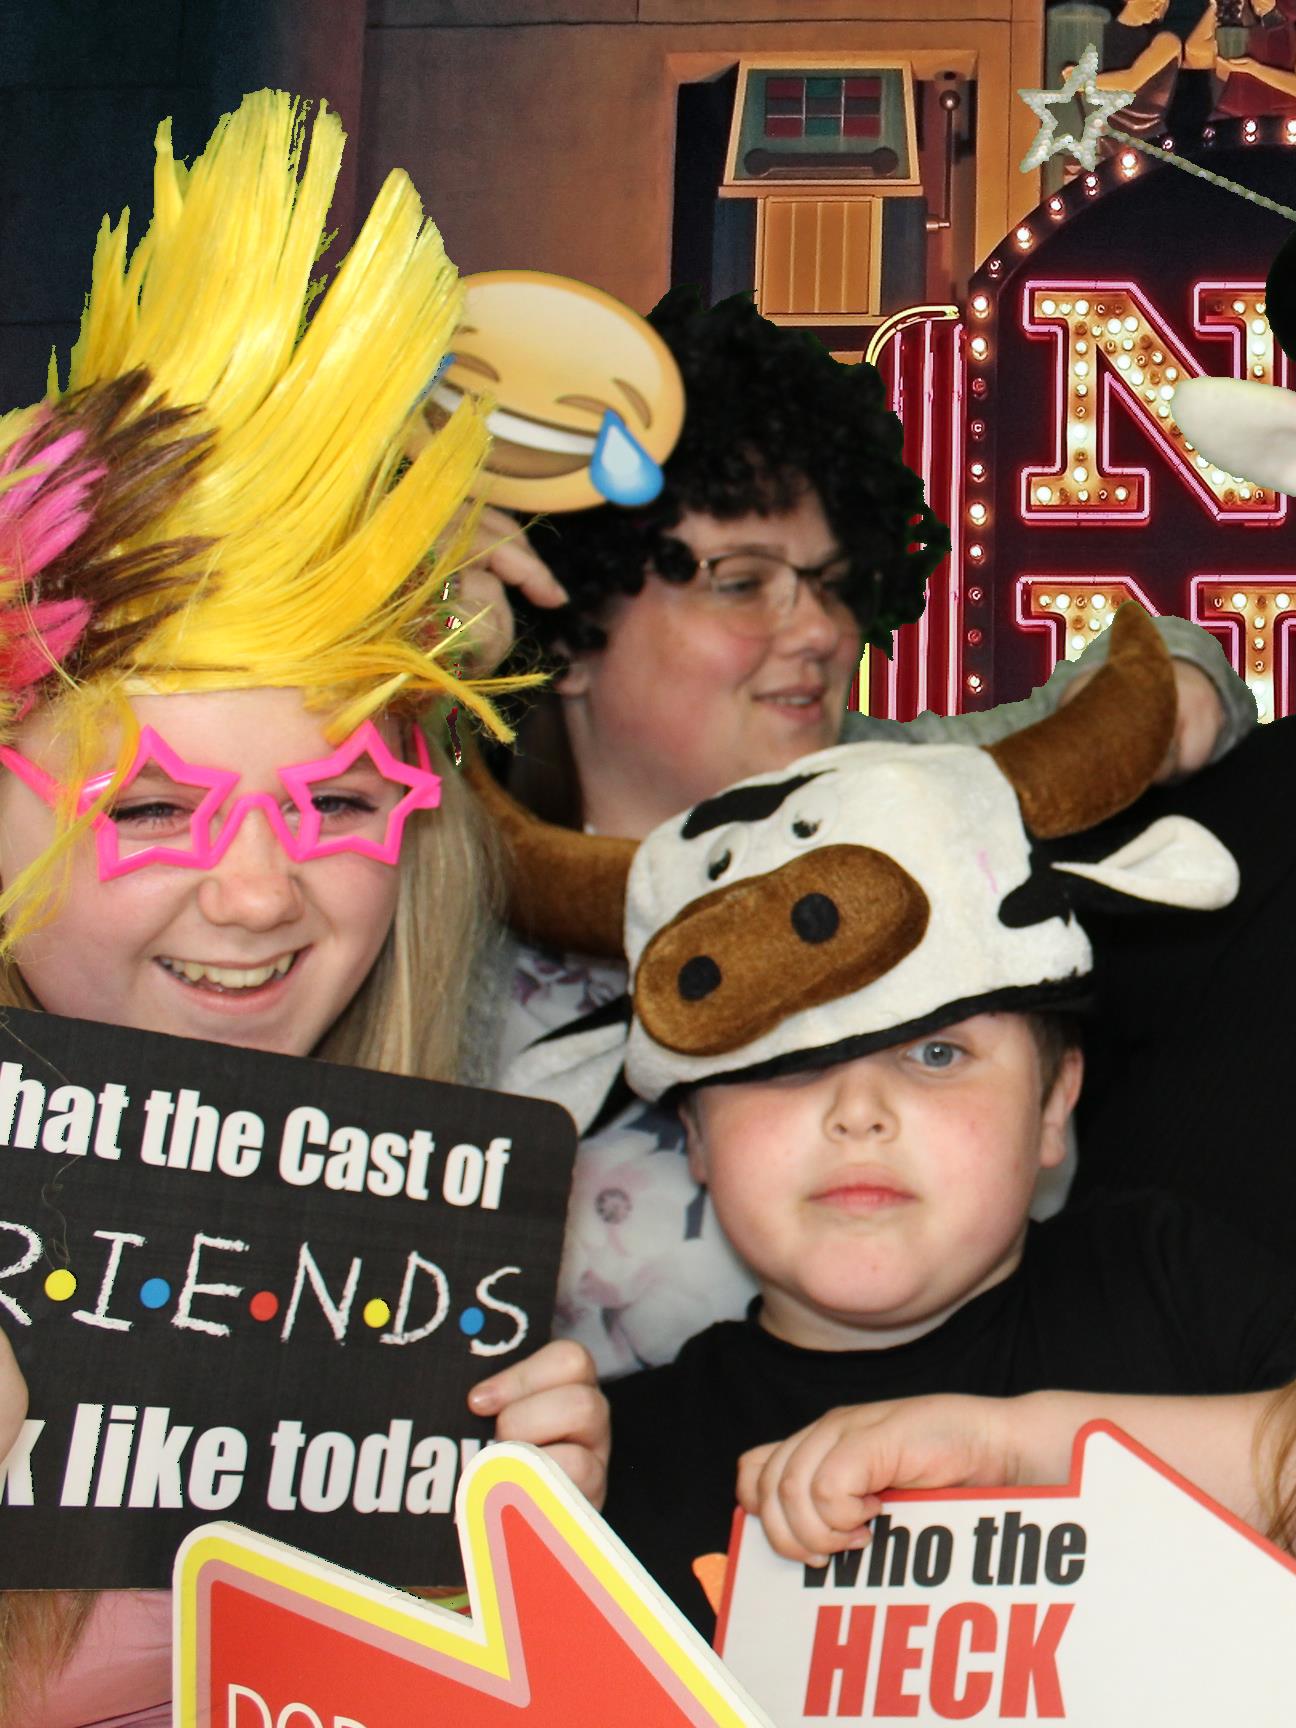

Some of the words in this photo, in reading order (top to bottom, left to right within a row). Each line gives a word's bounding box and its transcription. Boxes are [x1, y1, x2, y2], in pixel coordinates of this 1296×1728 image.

[141, 1089, 265, 1178] the
[278, 1107, 434, 1200] Cast
[442, 1137, 511, 1210] of
[59, 1403, 249, 1509] like
[972, 1511, 1087, 1586] the
[802, 1601, 1076, 1719] HECK
